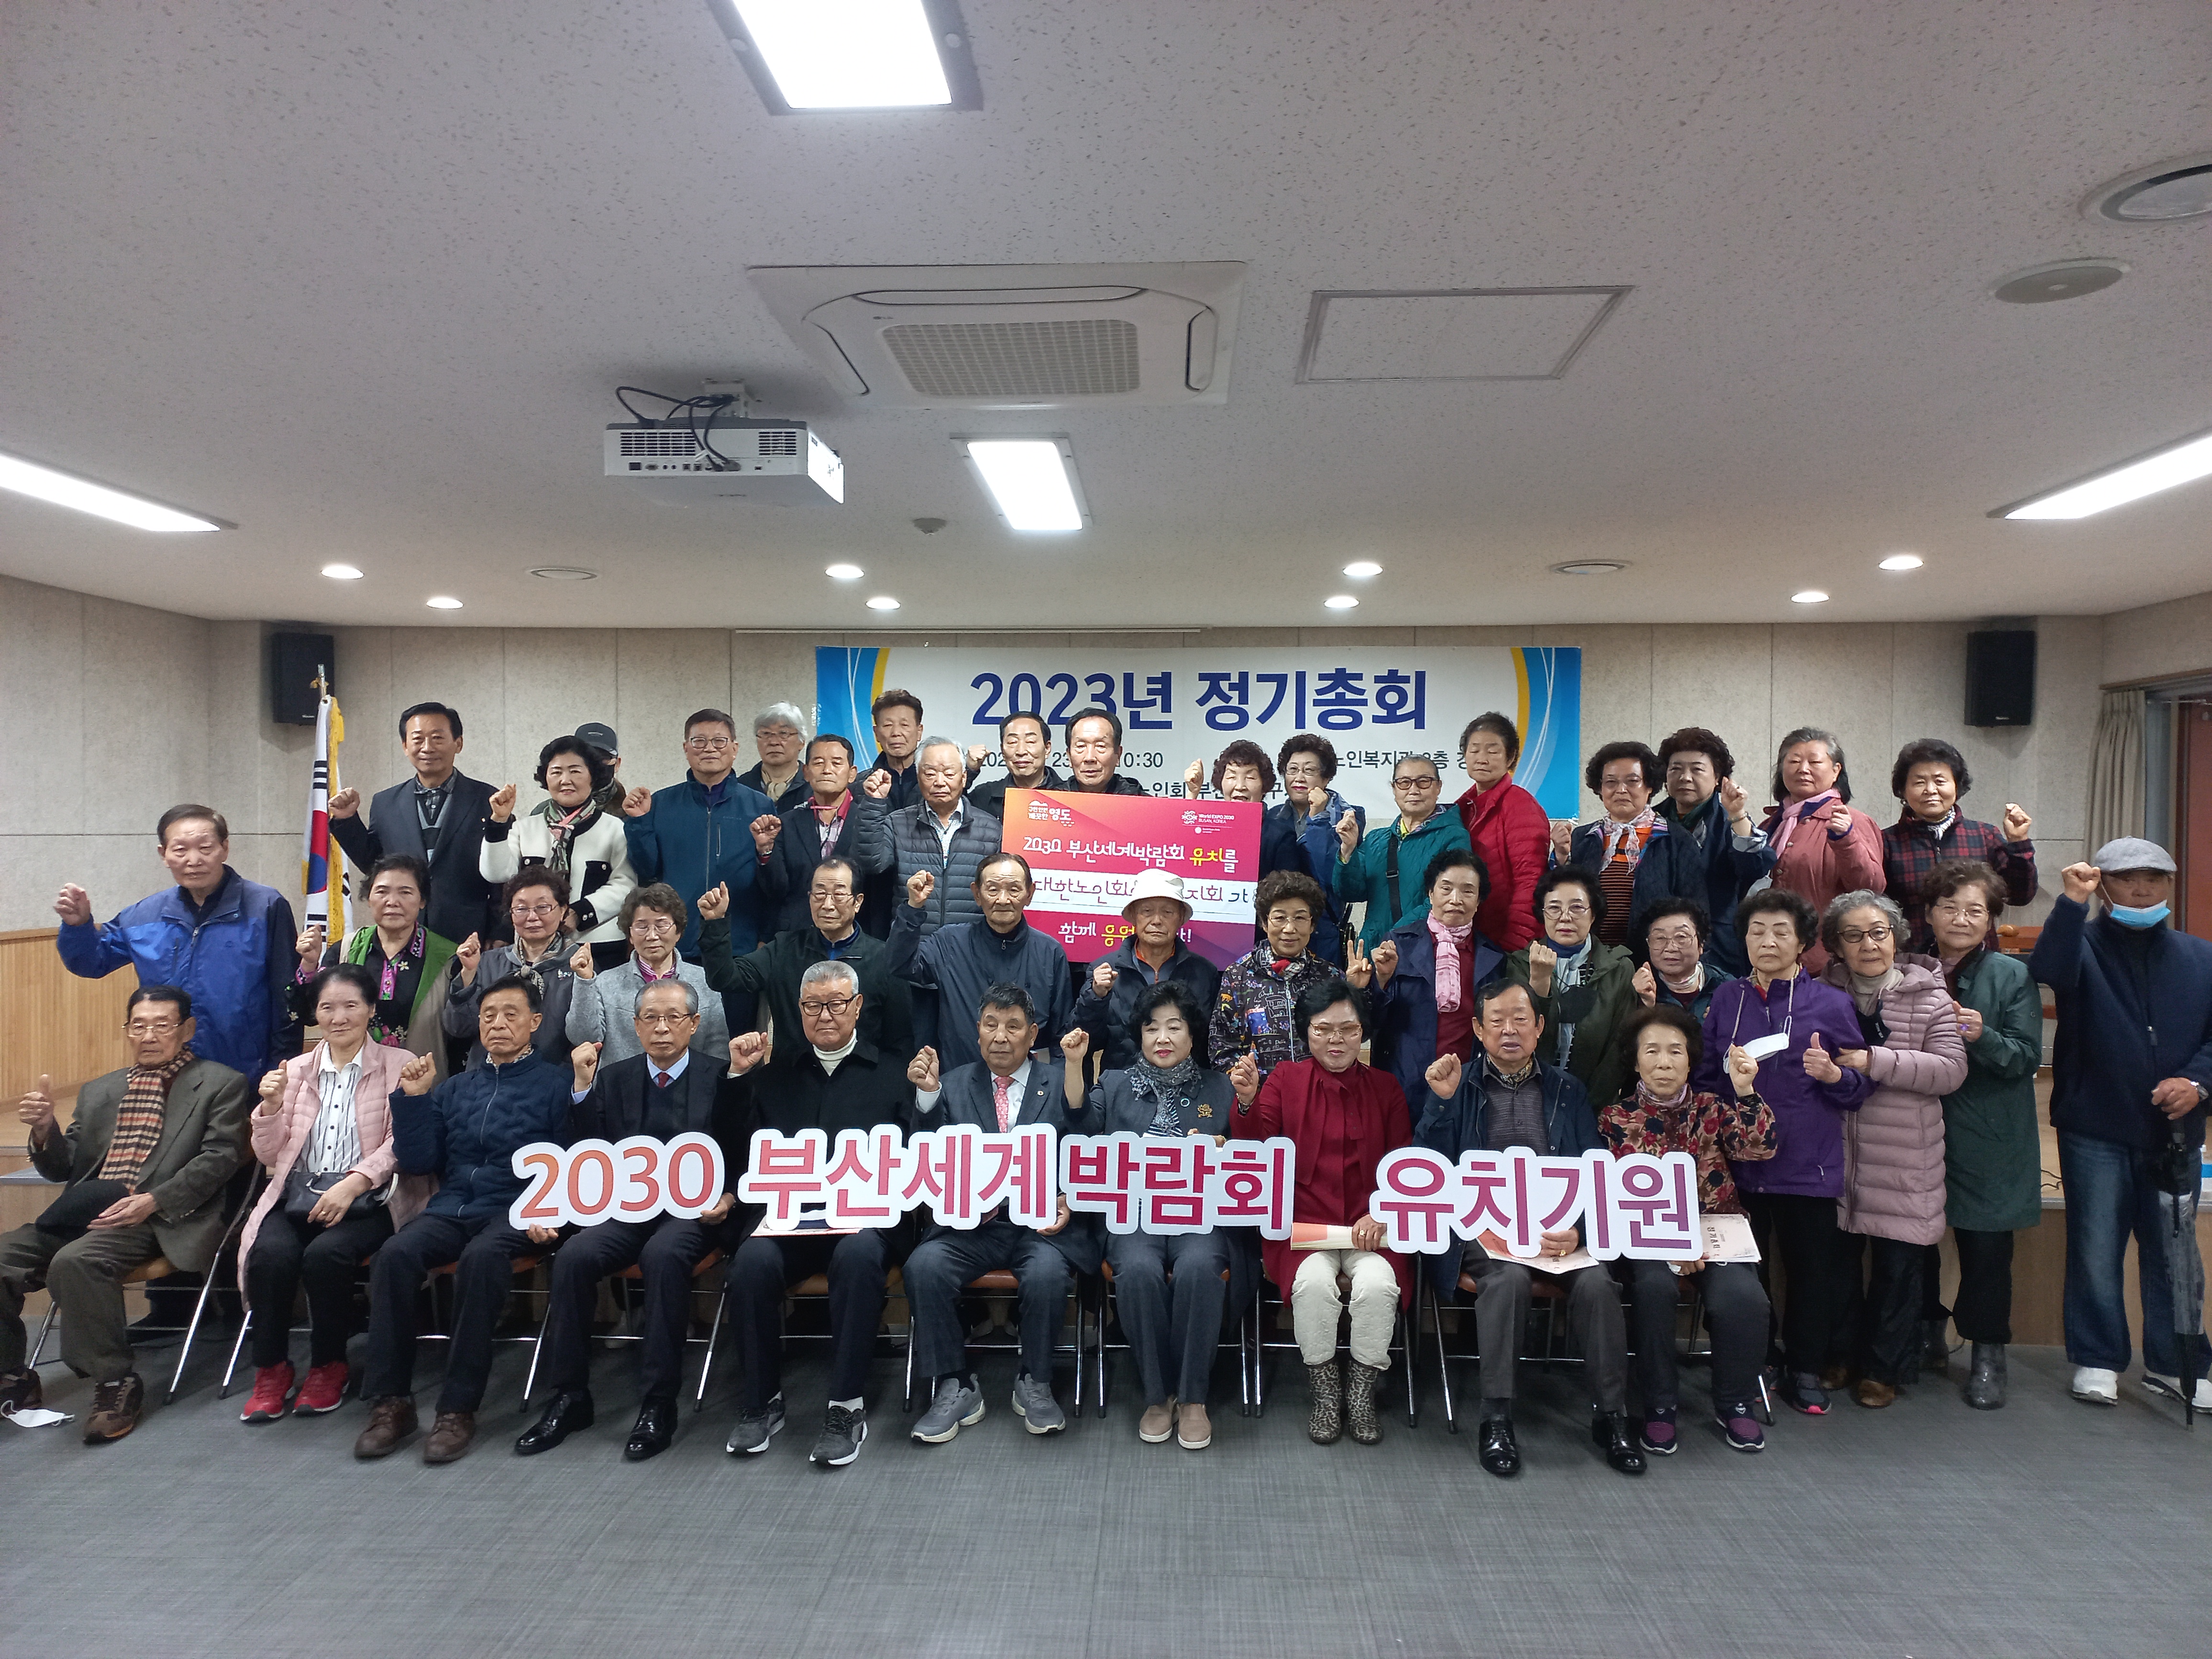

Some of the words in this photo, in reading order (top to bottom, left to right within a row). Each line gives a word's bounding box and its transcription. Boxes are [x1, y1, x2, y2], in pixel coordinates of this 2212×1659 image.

[971, 672, 1172, 730] 2023년
[1196, 667, 1426, 731] 정기총회
[1118, 752, 1163, 767] 0:30
[1143, 782, 1185, 799] 인회
[1049, 808, 1072, 821] 영도
[1023, 837, 1062, 854] 2030
[1066, 840, 1184, 867] 부산세계박람회
[1189, 848, 1239, 873] 유치를
[1058, 921, 1096, 943] 함께
[520, 1143, 715, 1219] 2030
[1380, 1157, 1692, 1250] 유치기원
